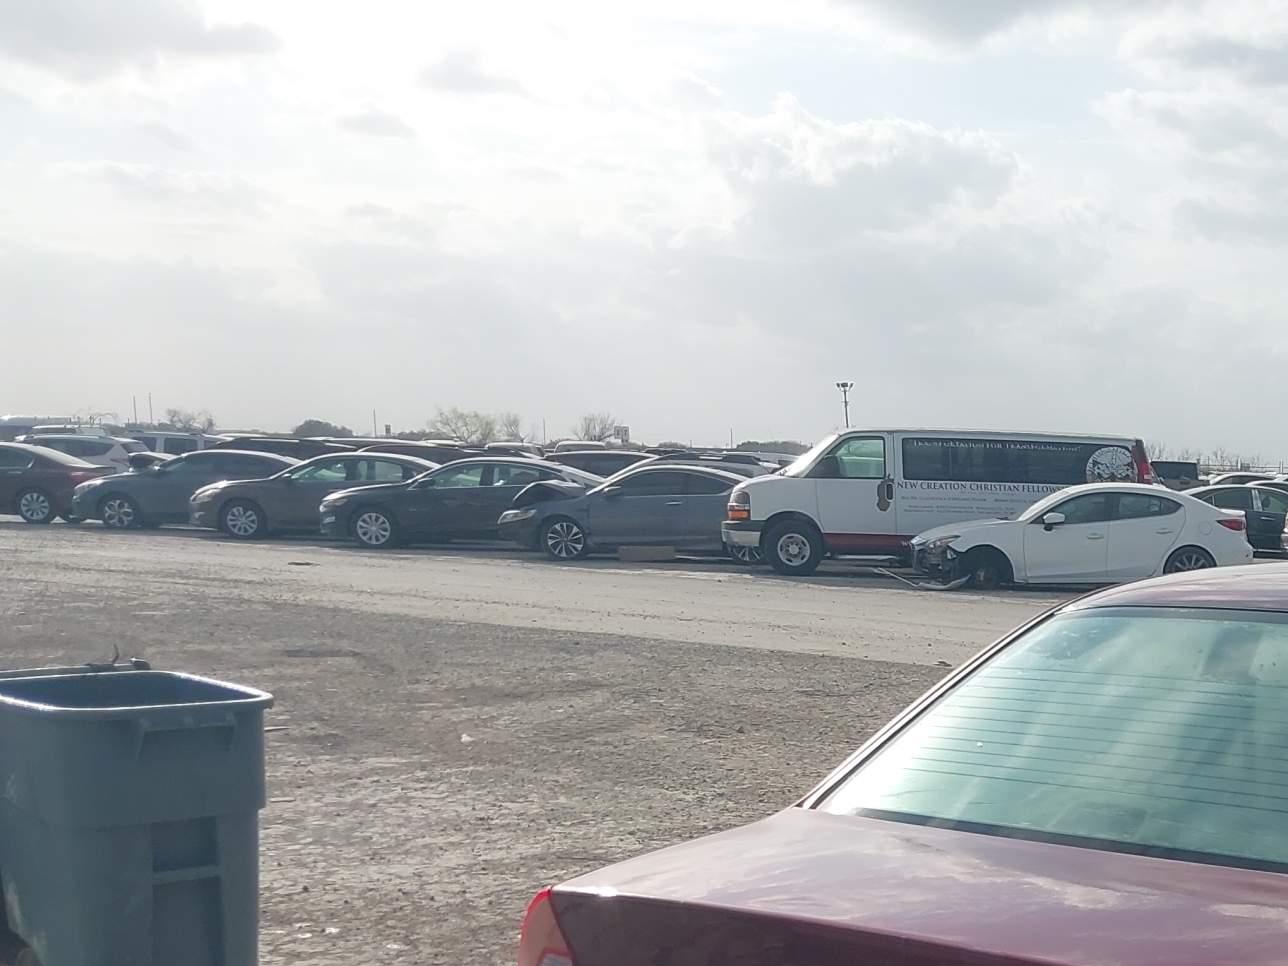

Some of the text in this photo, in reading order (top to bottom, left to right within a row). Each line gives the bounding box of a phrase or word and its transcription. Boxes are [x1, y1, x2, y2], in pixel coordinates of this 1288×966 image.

[896, 481, 919, 489] NEW
[920, 482, 967, 491] CREATION
[969, 483, 1020, 492] CHRISTIAN
